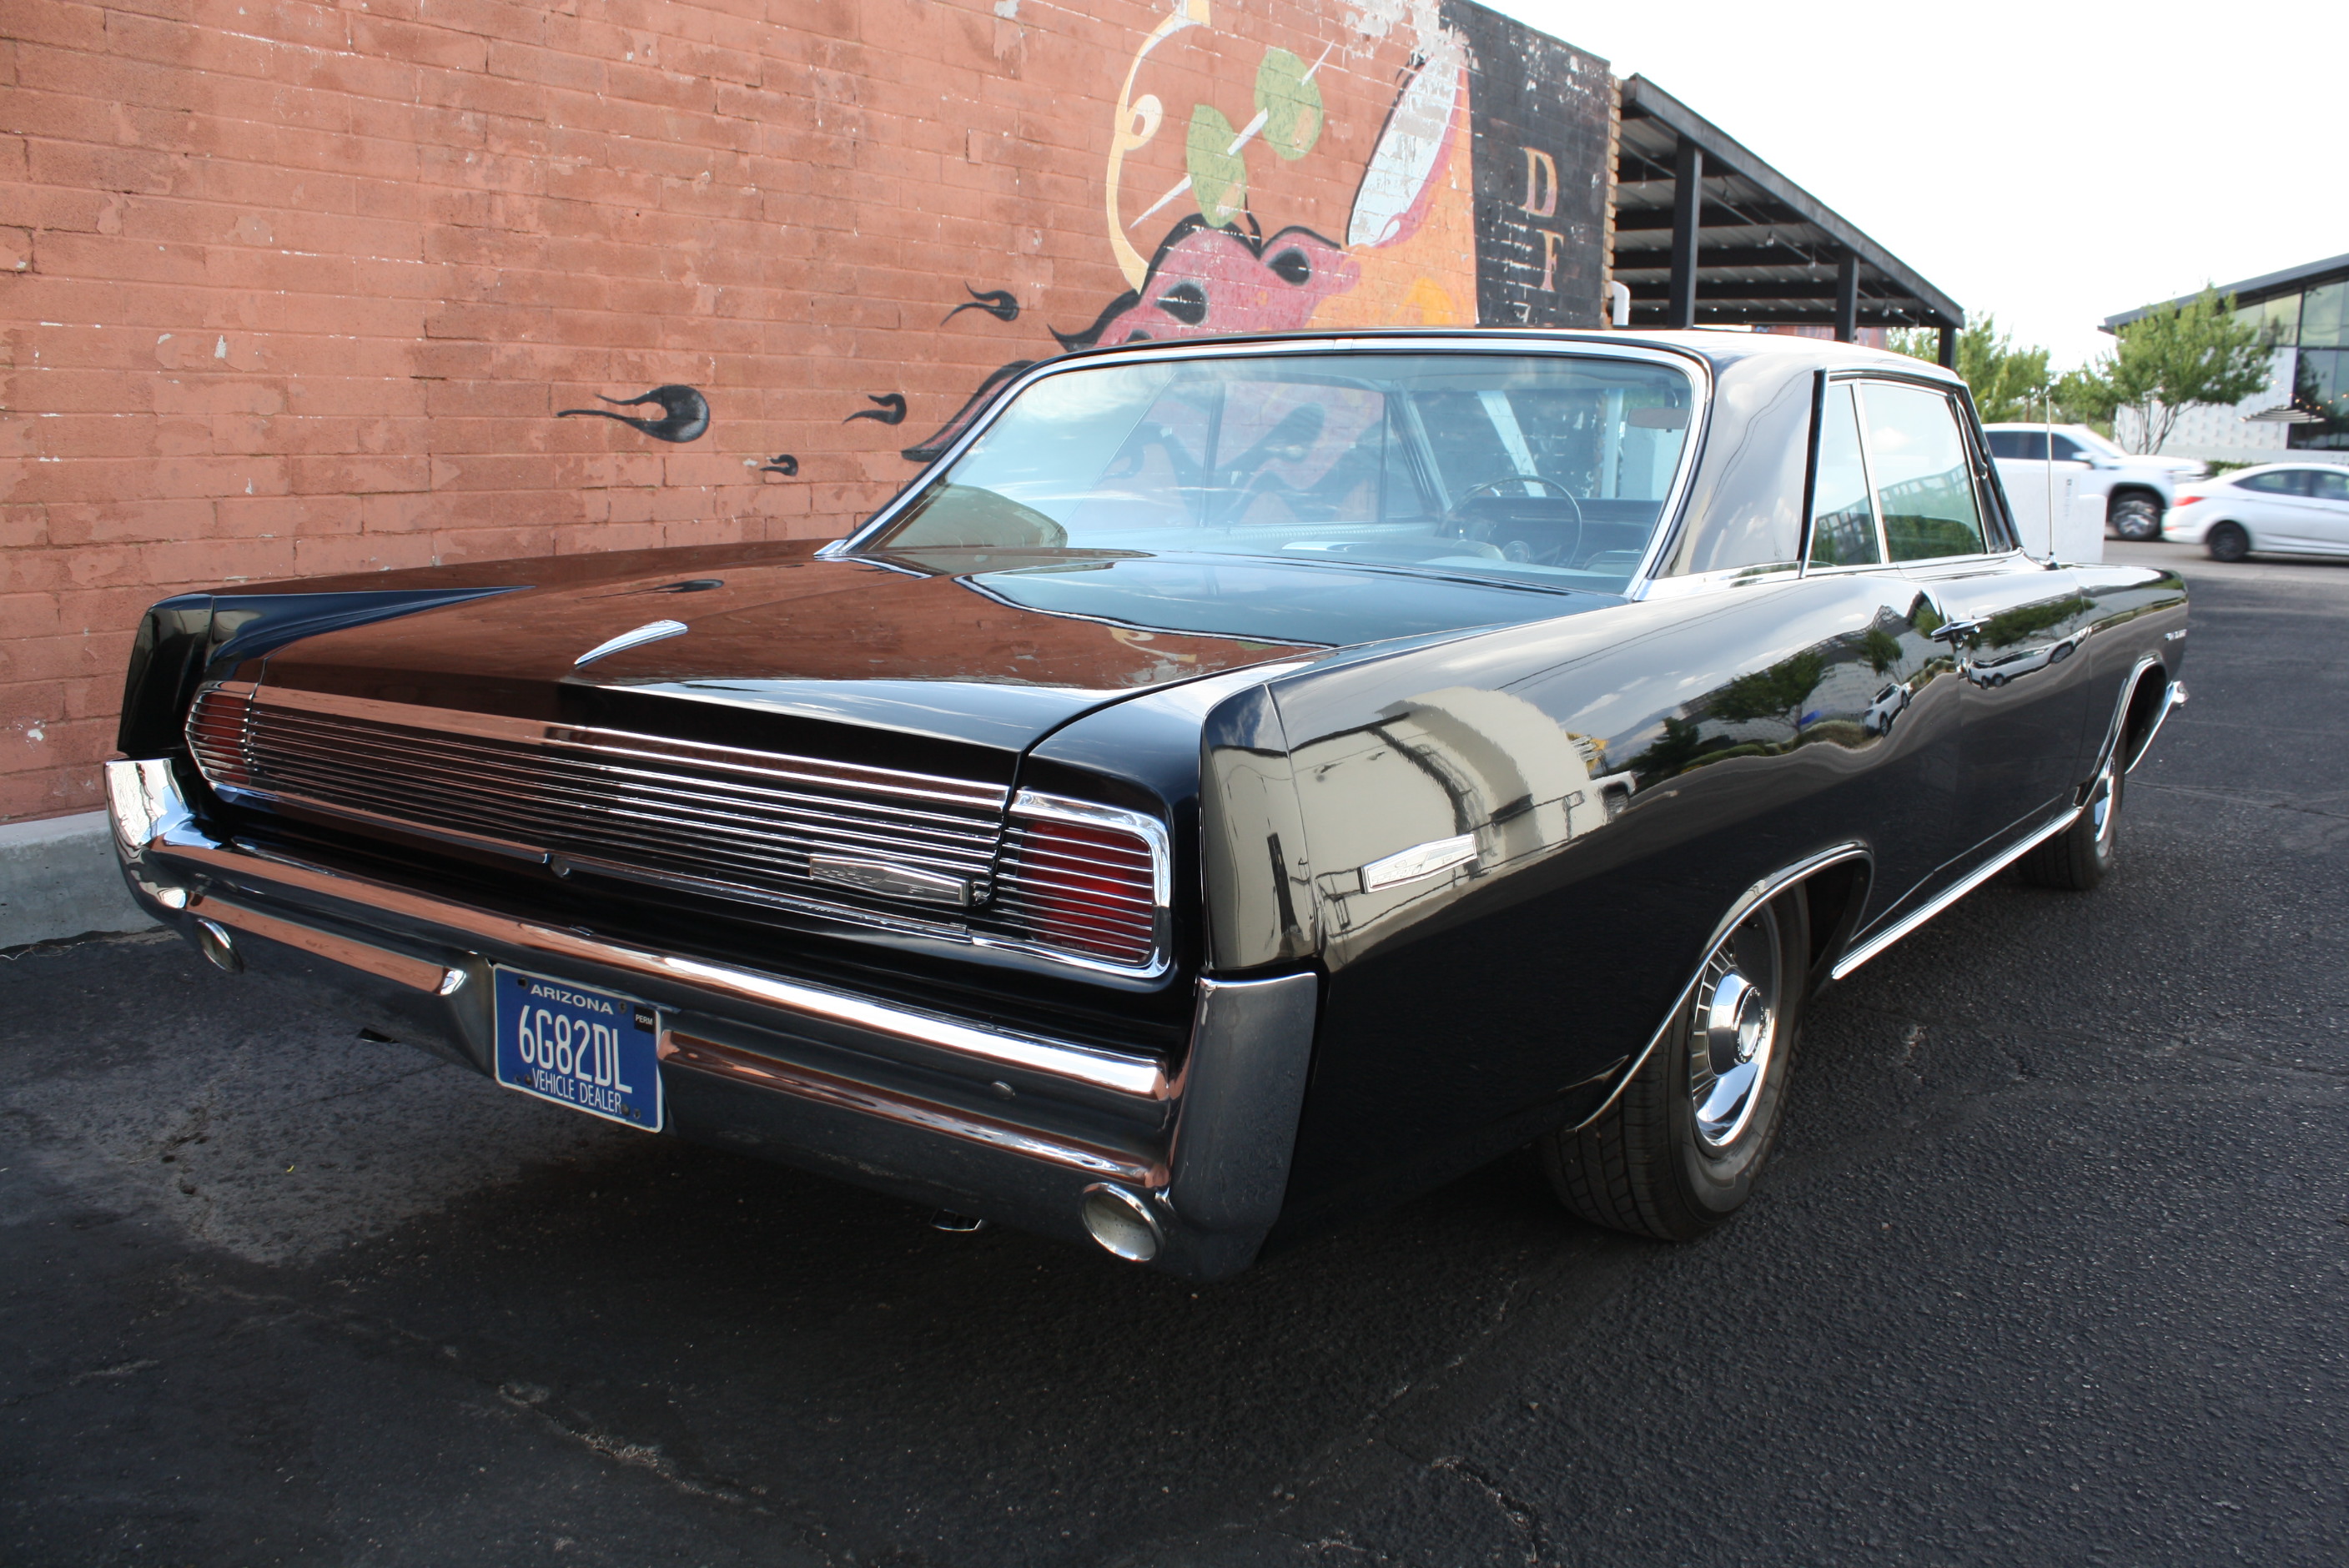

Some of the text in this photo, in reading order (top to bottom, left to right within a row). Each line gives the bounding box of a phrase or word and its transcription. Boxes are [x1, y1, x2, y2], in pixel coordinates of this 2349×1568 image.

[1518, 147, 1558, 219] D
[1536, 229, 1565, 293] F
[530, 983, 615, 1016] ARIZONA
[634, 1013, 653, 1026] PERM
[519, 1005, 633, 1093] 6G82DL
[532, 1067, 623, 1115] VEHICLE DEALER
